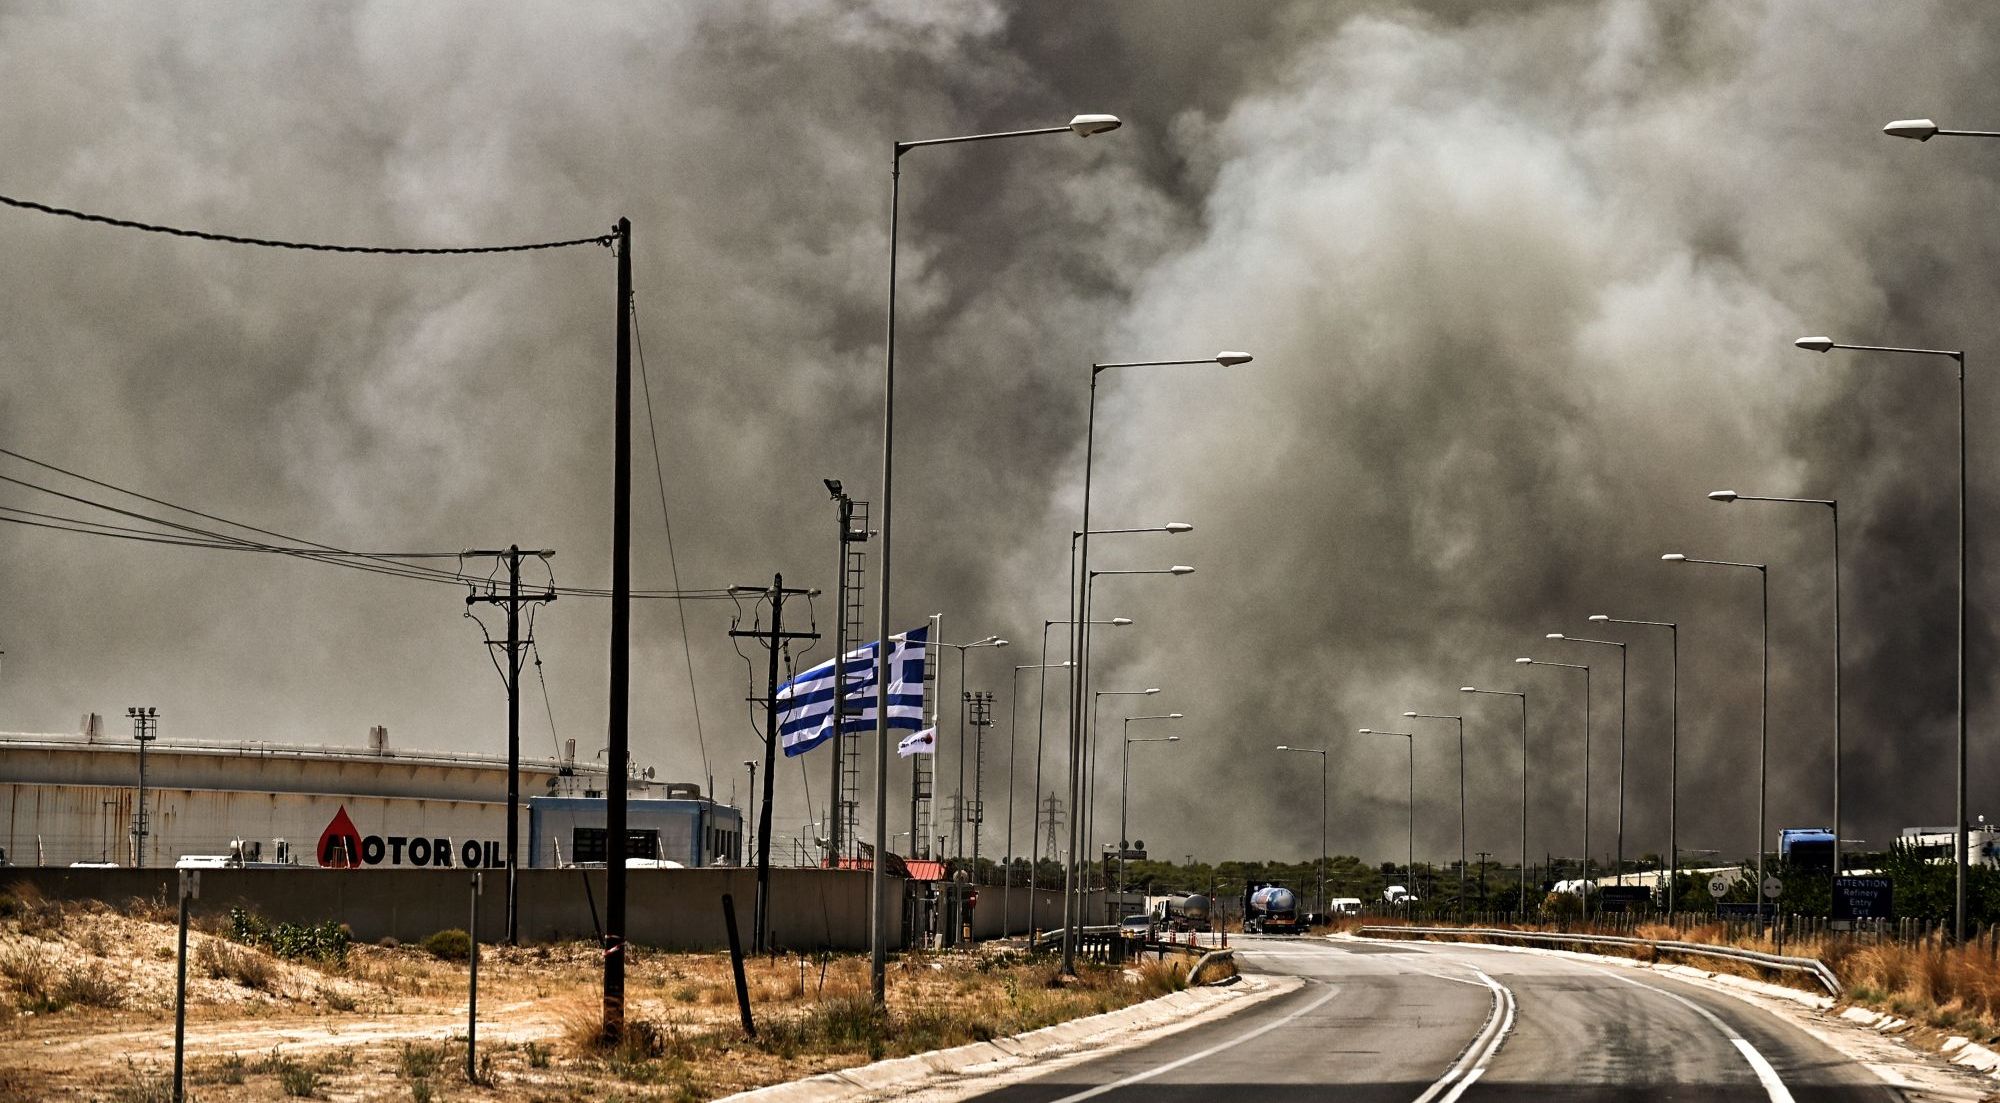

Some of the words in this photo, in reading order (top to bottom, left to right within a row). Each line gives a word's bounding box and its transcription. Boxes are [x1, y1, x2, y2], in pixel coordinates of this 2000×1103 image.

[323, 834, 453, 867] MOTOR
[461, 839, 506, 869] OIL
[1712, 882, 1724, 891] 50
[1836, 879, 1888, 888] ATTENTION
[1843, 888, 1879, 899] Refinery
[1849, 898, 1872, 907] Entry
[1852, 907, 1869, 916] Exit
